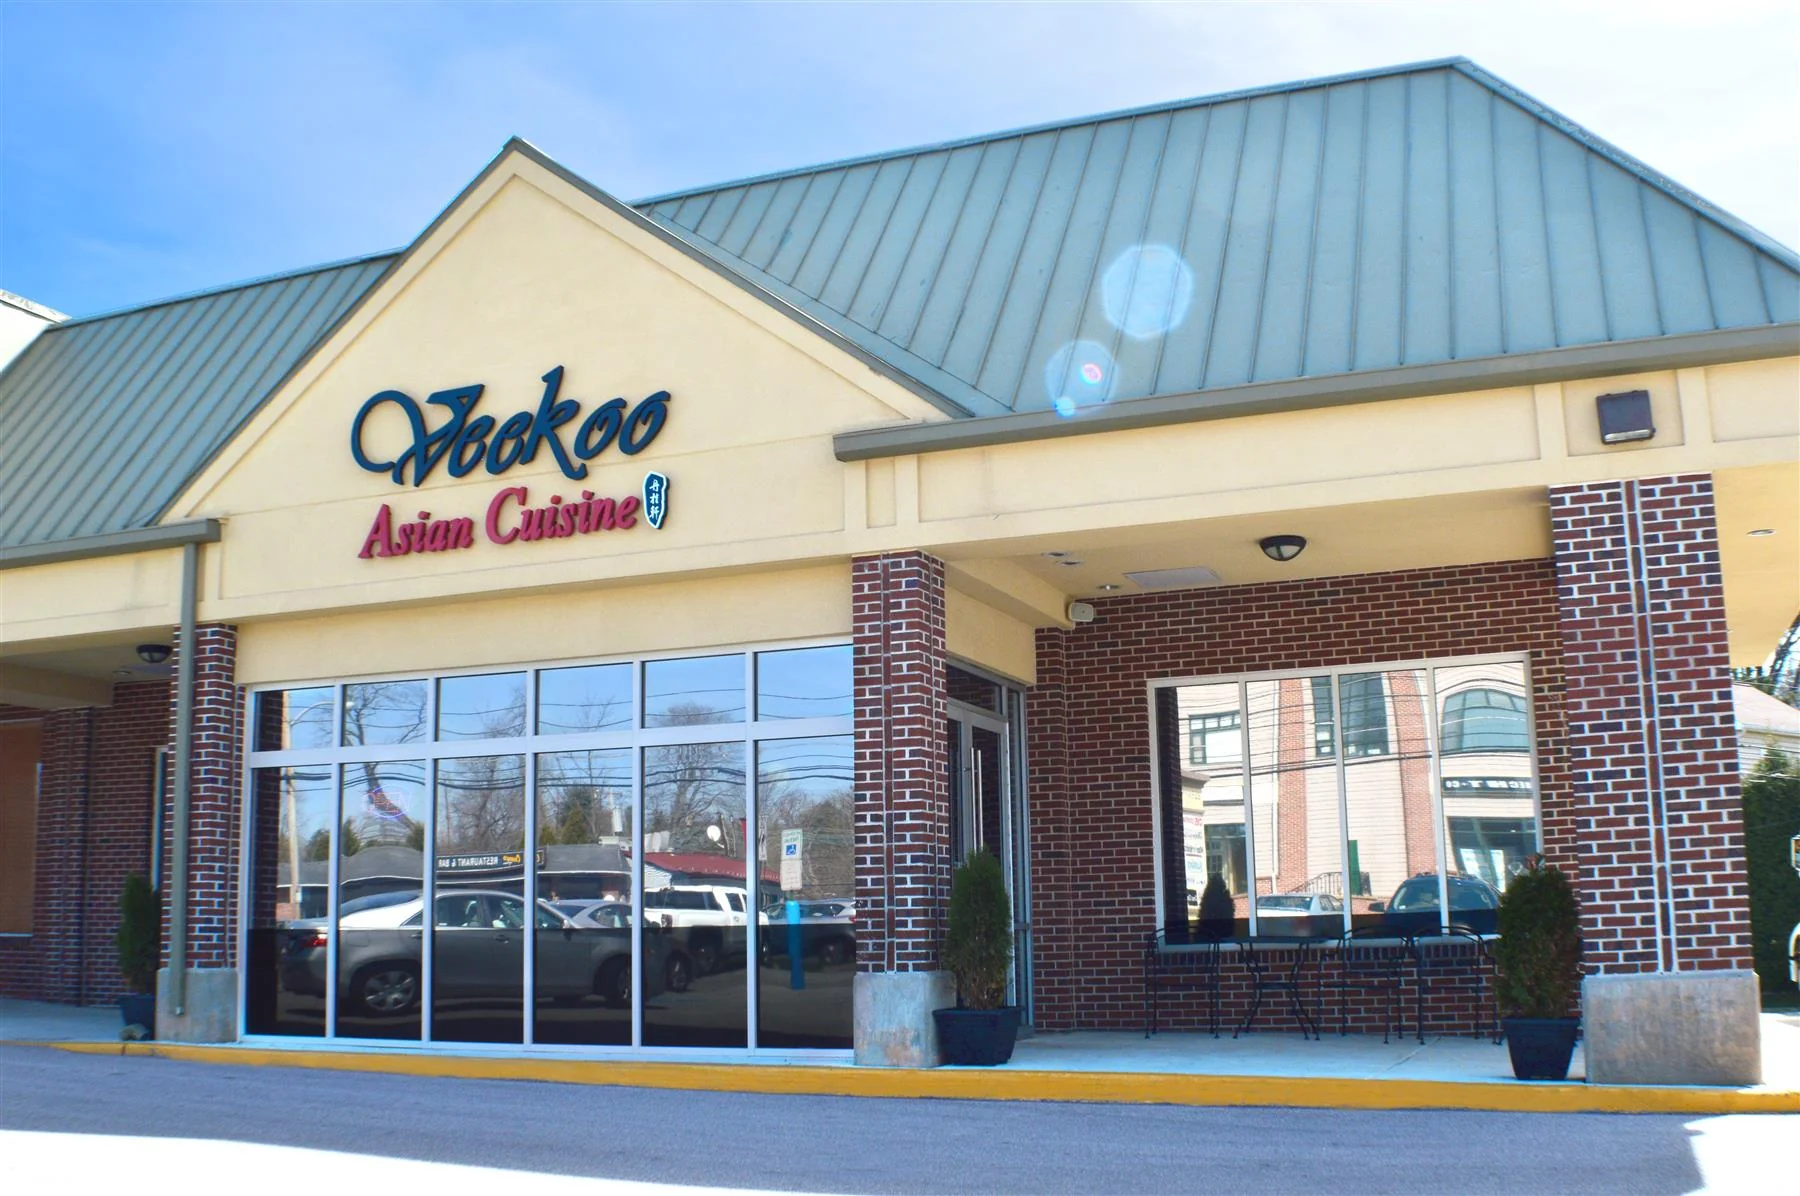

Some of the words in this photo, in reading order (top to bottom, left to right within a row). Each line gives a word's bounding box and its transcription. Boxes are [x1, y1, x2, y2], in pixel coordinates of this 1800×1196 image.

[351, 365, 671, 487] Veekoo
[358, 504, 474, 559] Asian
[485, 486, 641, 545] Cuisine
